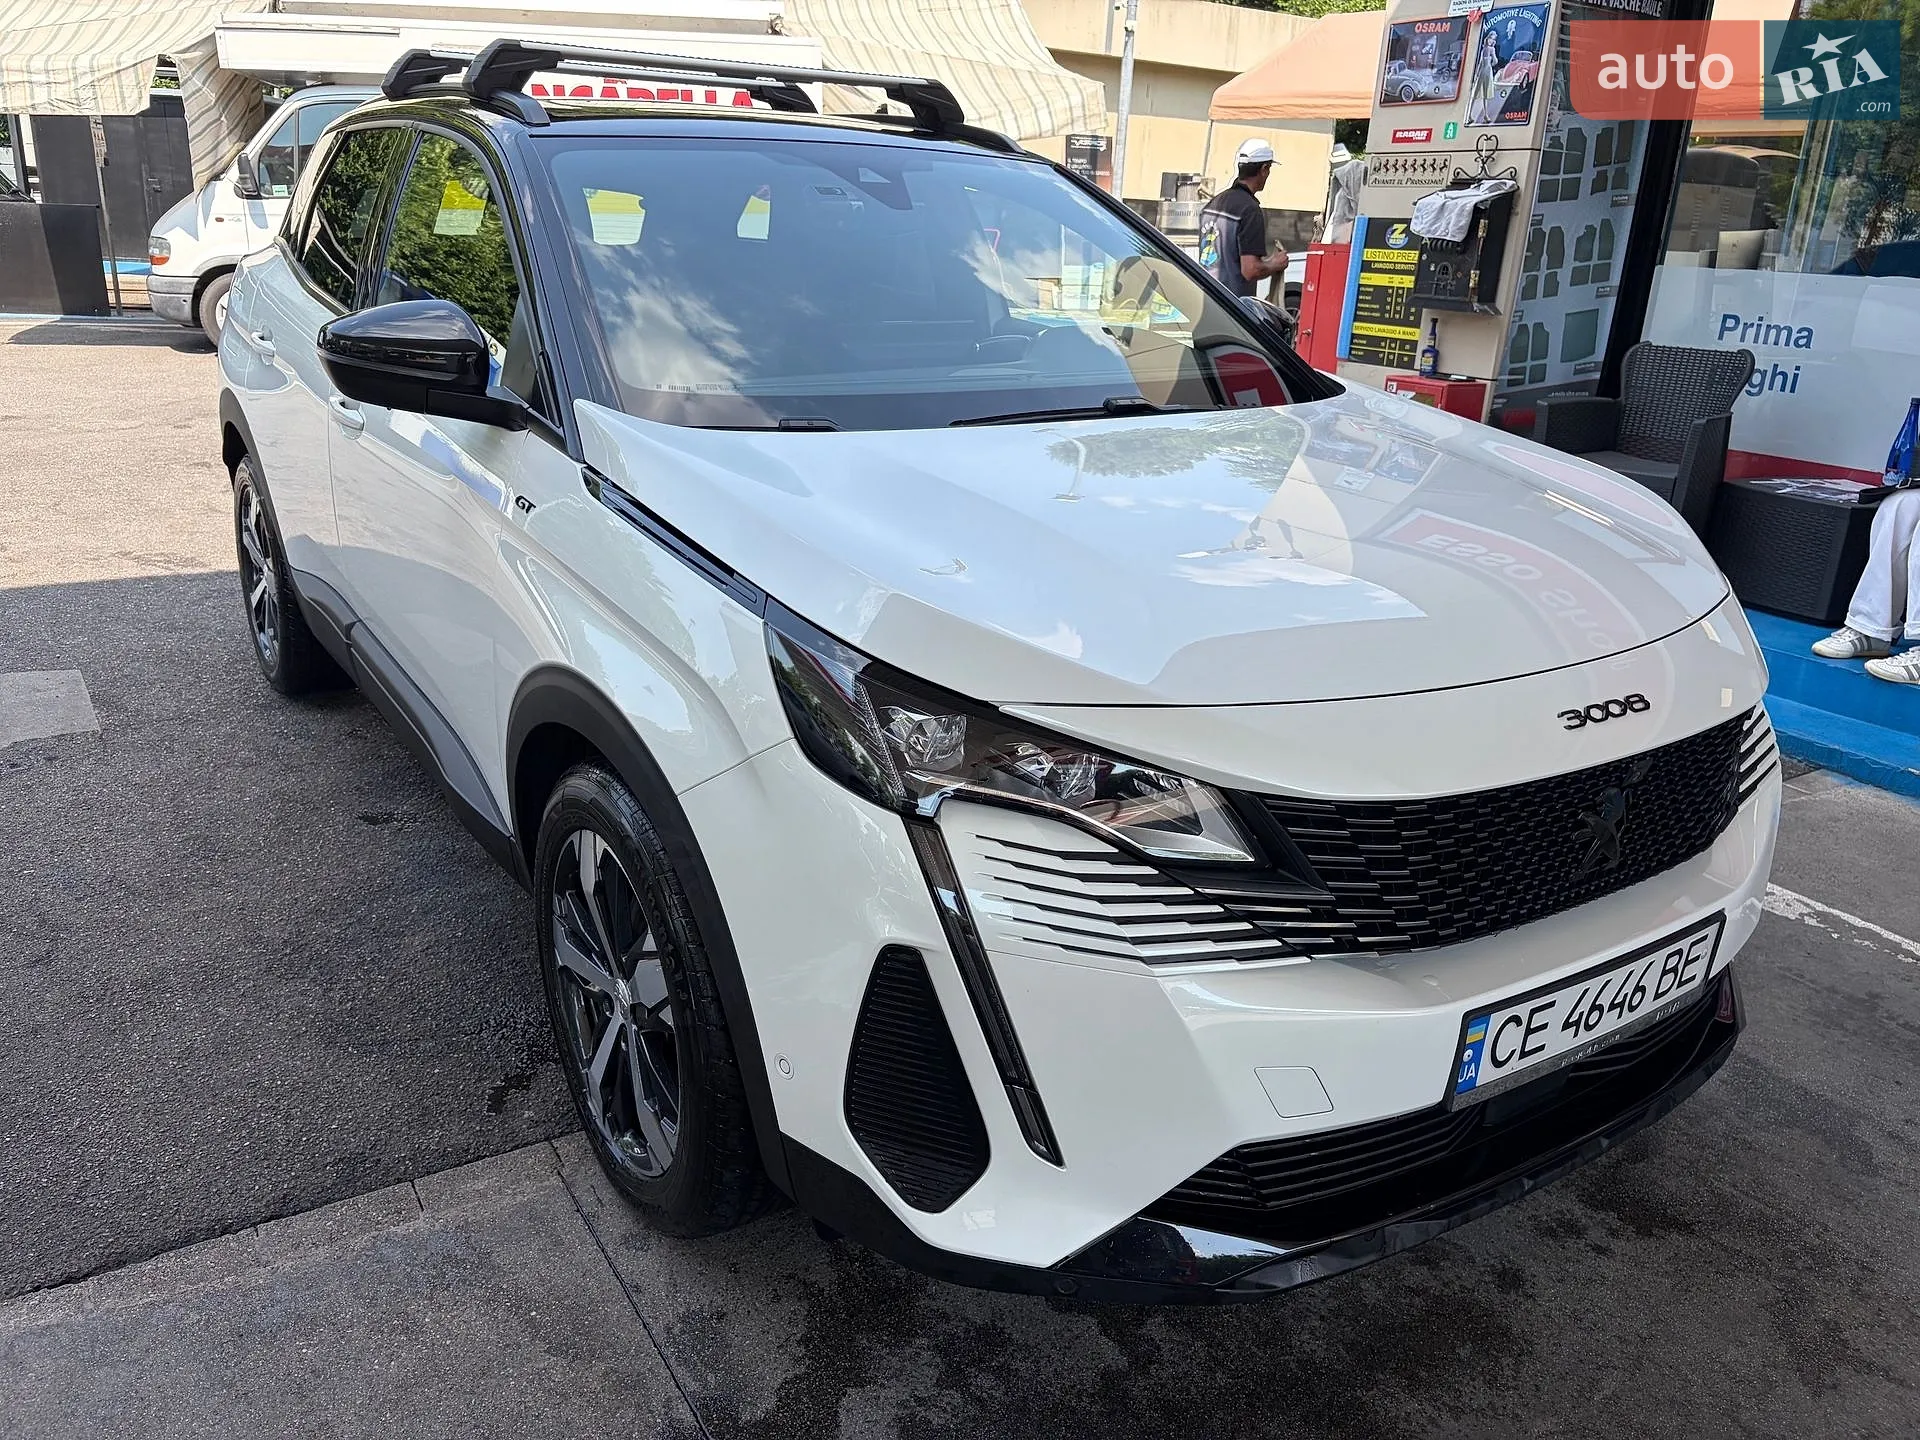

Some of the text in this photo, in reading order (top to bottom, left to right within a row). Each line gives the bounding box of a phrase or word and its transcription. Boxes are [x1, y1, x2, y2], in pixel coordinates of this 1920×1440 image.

[1415, 22, 1450, 33] OSRAM
[1483, 8, 1542, 32] AUTOMOTIVE LIGHTING
[1504, 111, 1528, 119] OSRAM
[1395, 130, 1430, 138] RADAR
[1365, 250, 1395, 260] LISTINO
[1717, 313, 1814, 349] Prima
[515, 495, 536, 514] GT
[1557, 693, 1651, 730] 3008
[1490, 999, 1557, 1069] CE
[1561, 959, 1657, 1039] 4646
[1652, 932, 1710, 1002] BE
[1457, 1062, 1476, 1084] UA
